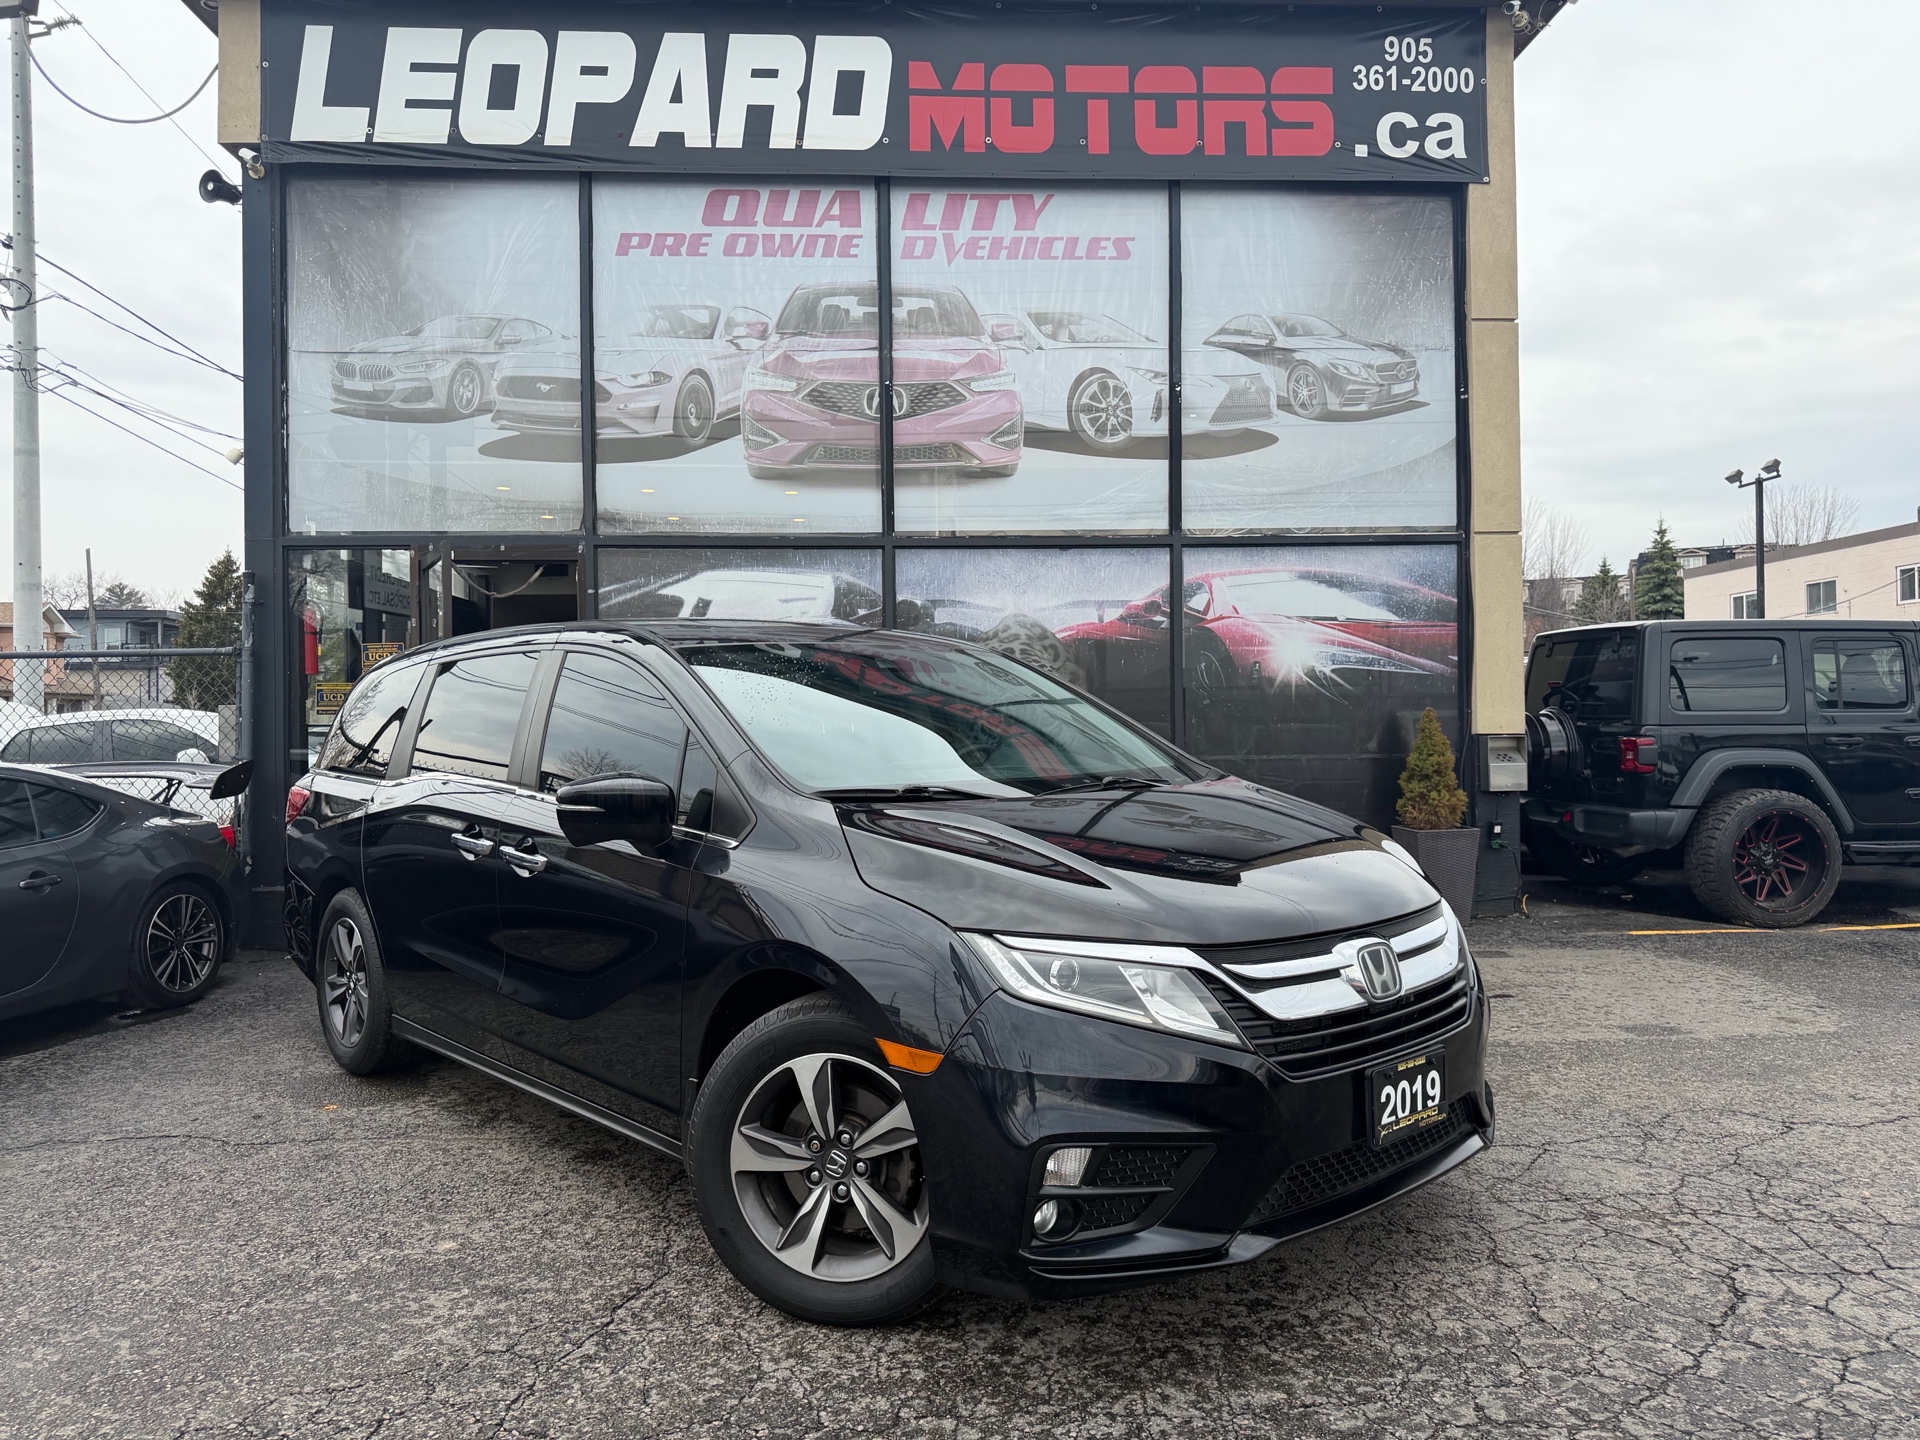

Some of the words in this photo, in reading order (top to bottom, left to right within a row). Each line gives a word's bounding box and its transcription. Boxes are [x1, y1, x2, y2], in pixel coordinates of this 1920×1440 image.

[1384, 36, 1433, 63] 905
[290, 25, 892, 150] LEOPARD
[908, 61, 1335, 157] MOTORS
[1352, 65, 1475, 94] 361-2000
[1353, 110, 1468, 159] .ca
[701, 189, 862, 228] QUA
[900, 193, 1055, 231] LITY
[615, 232, 712, 257] PRE
[722, 233, 863, 258] OWNE
[368, 652, 395, 661] UCD
[1380, 1069, 1440, 1125] 2019
[1393, 1106, 1438, 1130] LEOPARD
